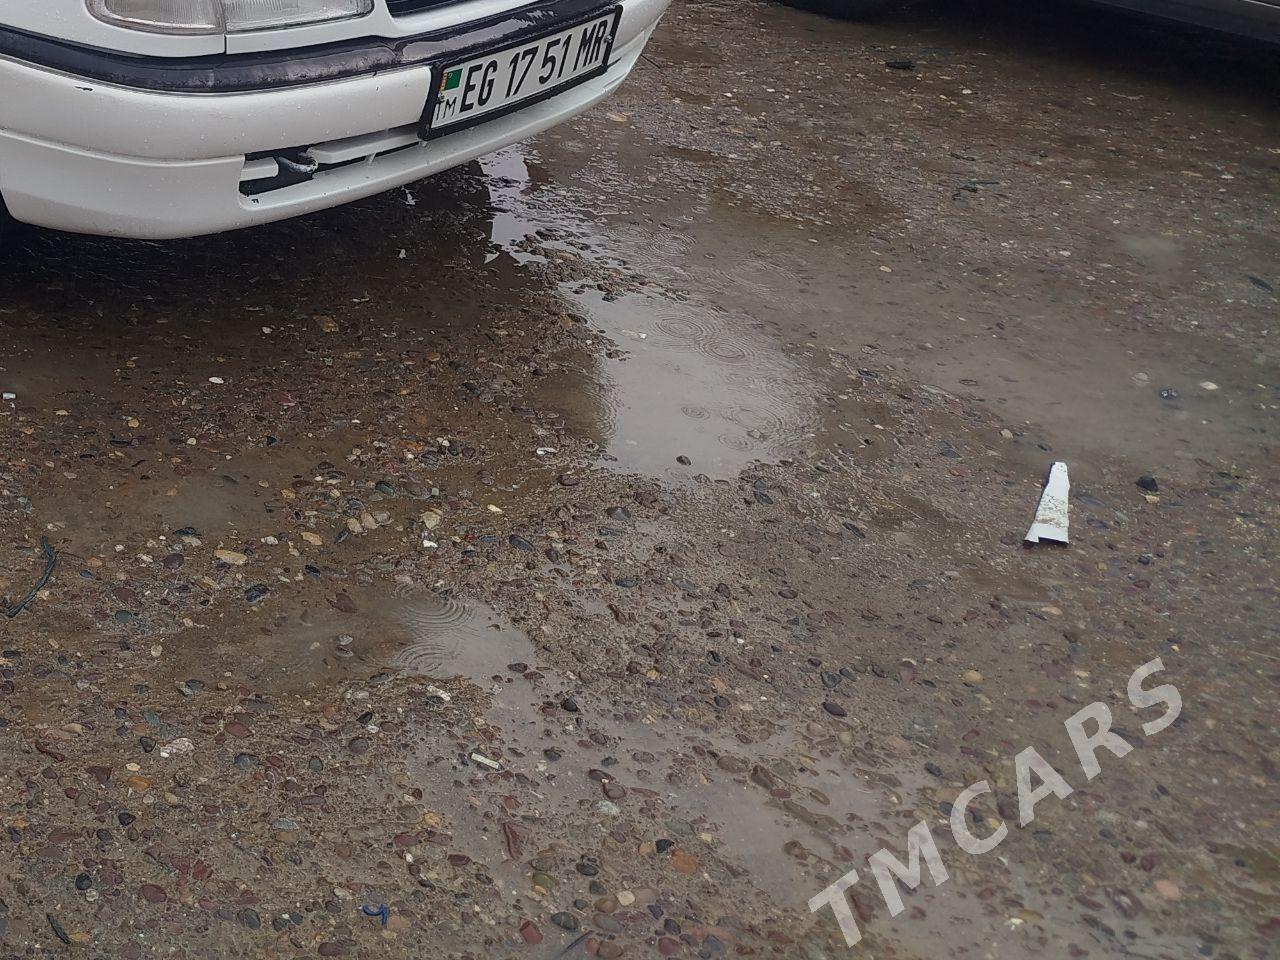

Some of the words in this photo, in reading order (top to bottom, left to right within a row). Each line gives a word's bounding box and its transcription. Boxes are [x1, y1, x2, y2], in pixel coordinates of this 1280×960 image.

[459, 60, 498, 113] EG
[573, 20, 608, 68] MR
[434, 98, 457, 121] TM
